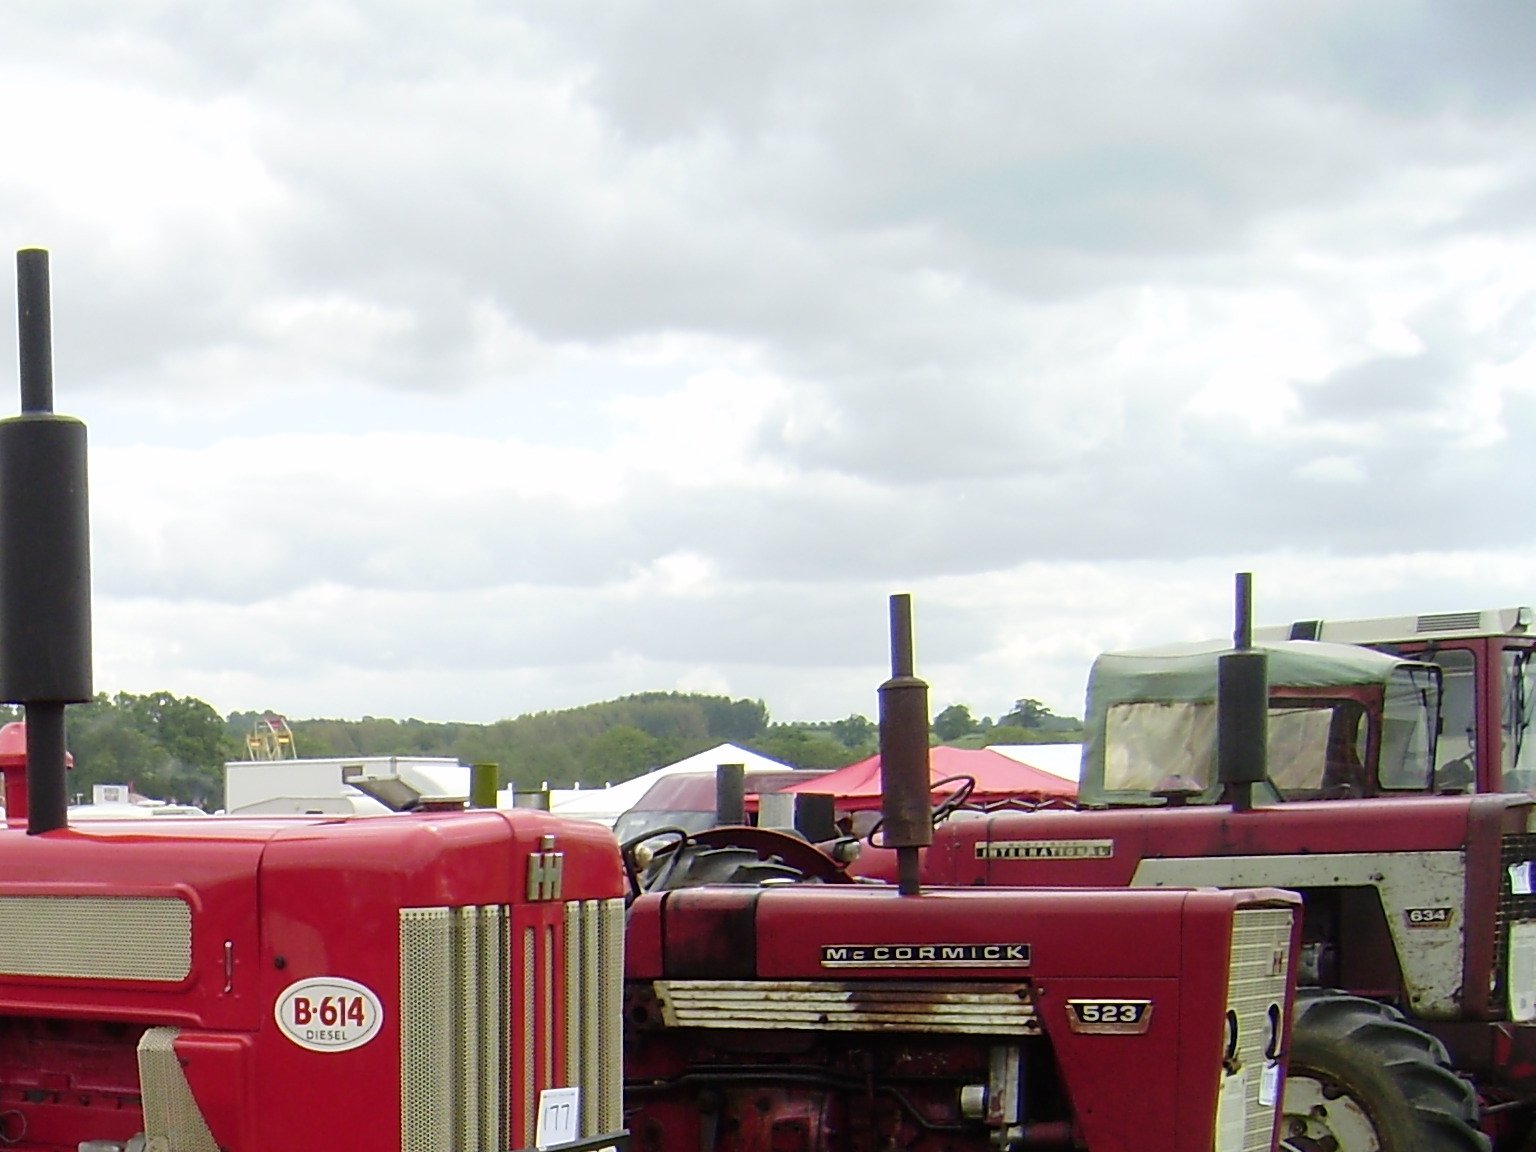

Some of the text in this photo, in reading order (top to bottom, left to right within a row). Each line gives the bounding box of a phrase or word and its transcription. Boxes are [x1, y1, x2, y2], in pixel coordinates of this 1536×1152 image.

[1410, 909, 1447, 922] 634
[825, 945, 1024, 961] McCORMICK
[1081, 1004, 1137, 1023] 523
[306, 1030, 348, 1041] DIESEL
[542, 1103, 570, 1132] 177
